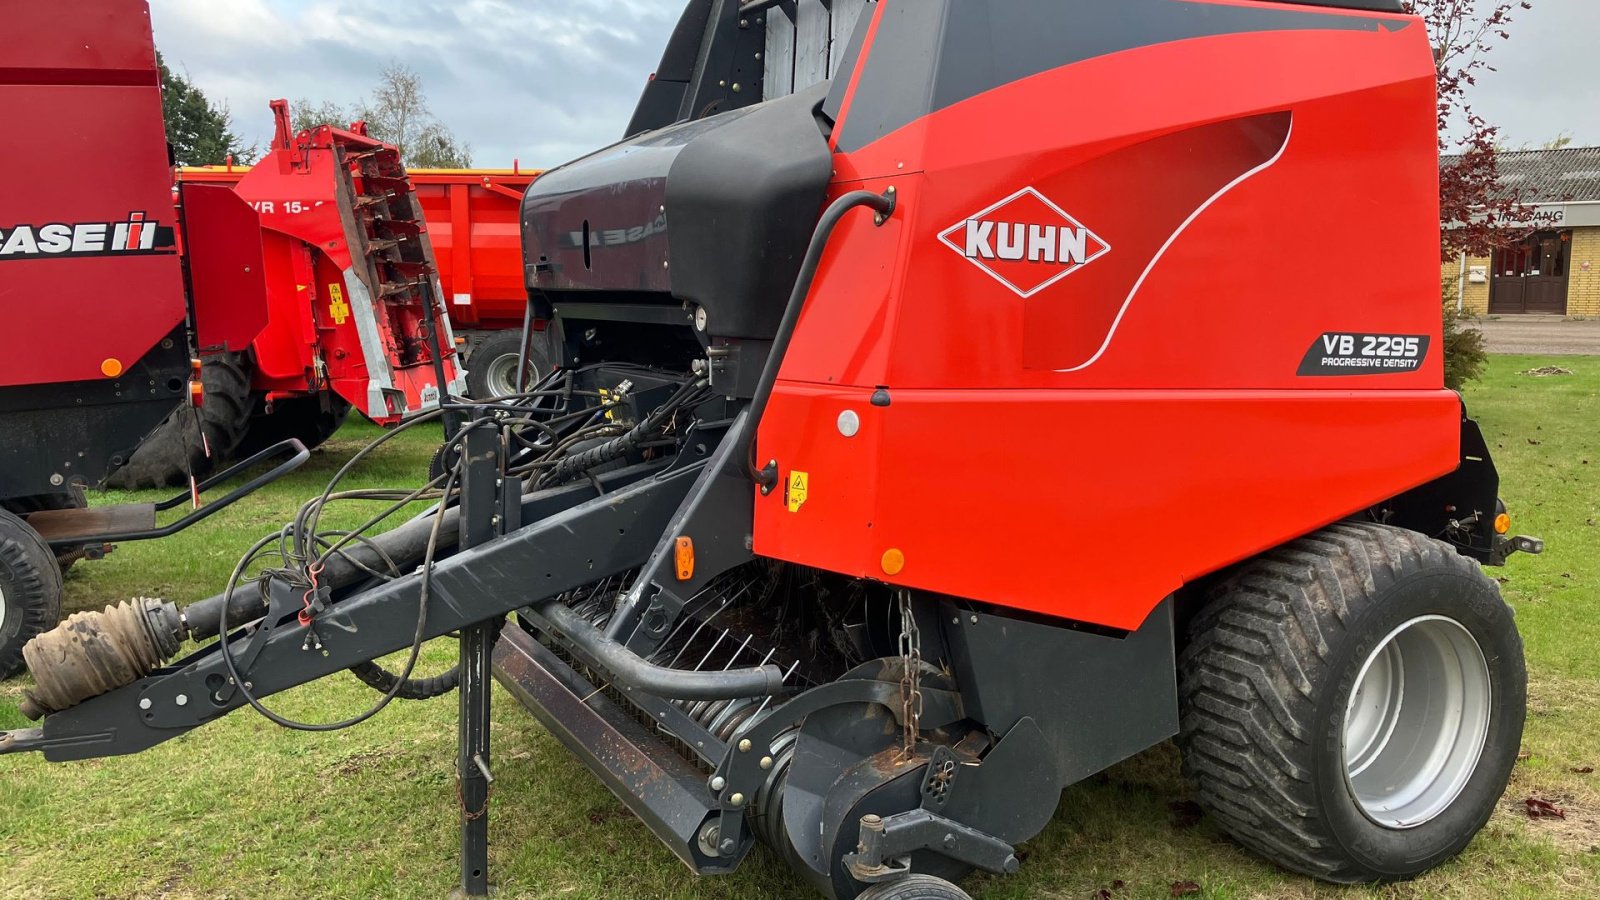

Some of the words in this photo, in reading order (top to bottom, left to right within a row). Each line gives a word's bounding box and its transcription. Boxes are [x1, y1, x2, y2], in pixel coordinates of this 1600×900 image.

[0, 224, 107, 254] ASE
[965, 218, 1087, 264] KUHN
[1322, 334, 1354, 355] VB
[1361, 336, 1420, 357] 2295
[1321, 357, 1381, 367] PROGRESSIVE
[1383, 358, 1418, 368] DENSITY
